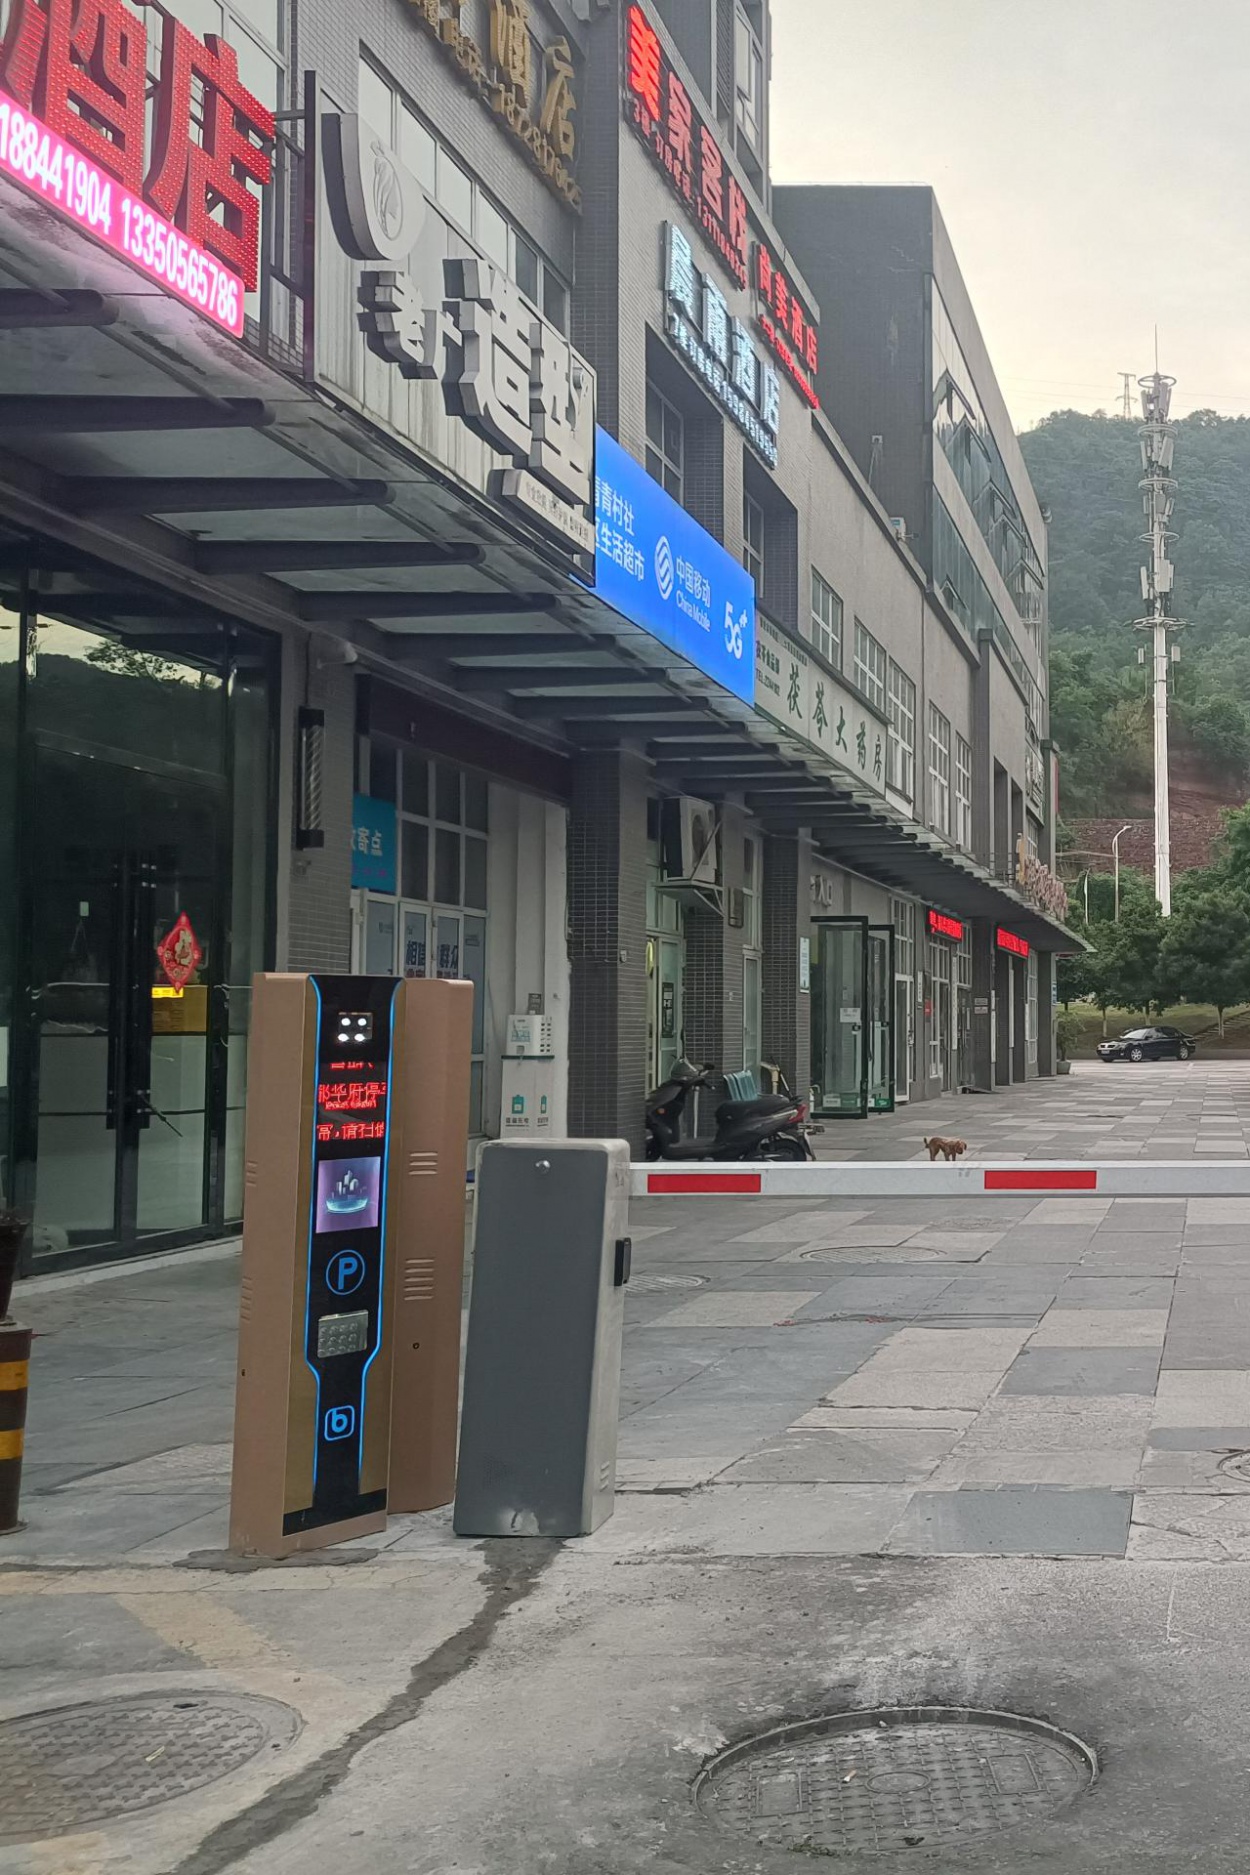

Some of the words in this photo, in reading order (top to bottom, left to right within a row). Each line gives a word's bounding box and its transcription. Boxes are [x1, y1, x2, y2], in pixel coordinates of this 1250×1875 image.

[0, 0, 276, 293] 酒店
[120, 197, 238, 328] 13350565786
[675, 555, 711, 608] 中国移动
[676, 590, 693, 618] China
[692, 598, 711, 633] Mobile
[338, 1257, 358, 1290] P
